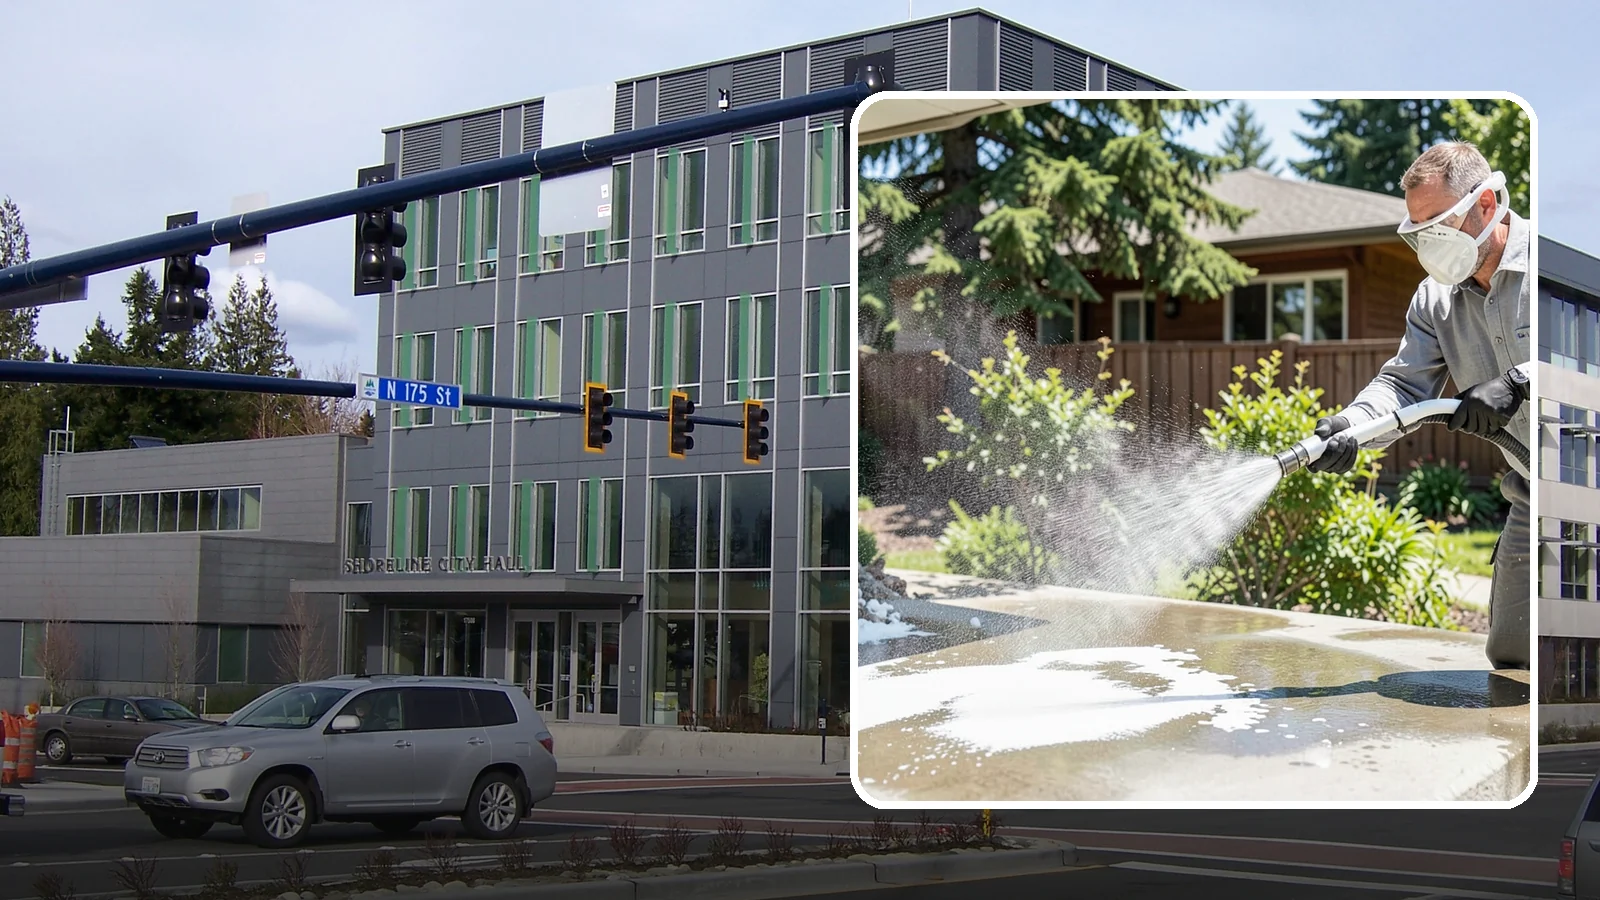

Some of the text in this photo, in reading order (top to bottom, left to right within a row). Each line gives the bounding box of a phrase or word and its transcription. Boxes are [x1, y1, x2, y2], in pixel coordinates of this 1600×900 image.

[387, 380, 451, 406] N 175 St
[344, 555, 525, 574] SHORELINE CITY HALL
